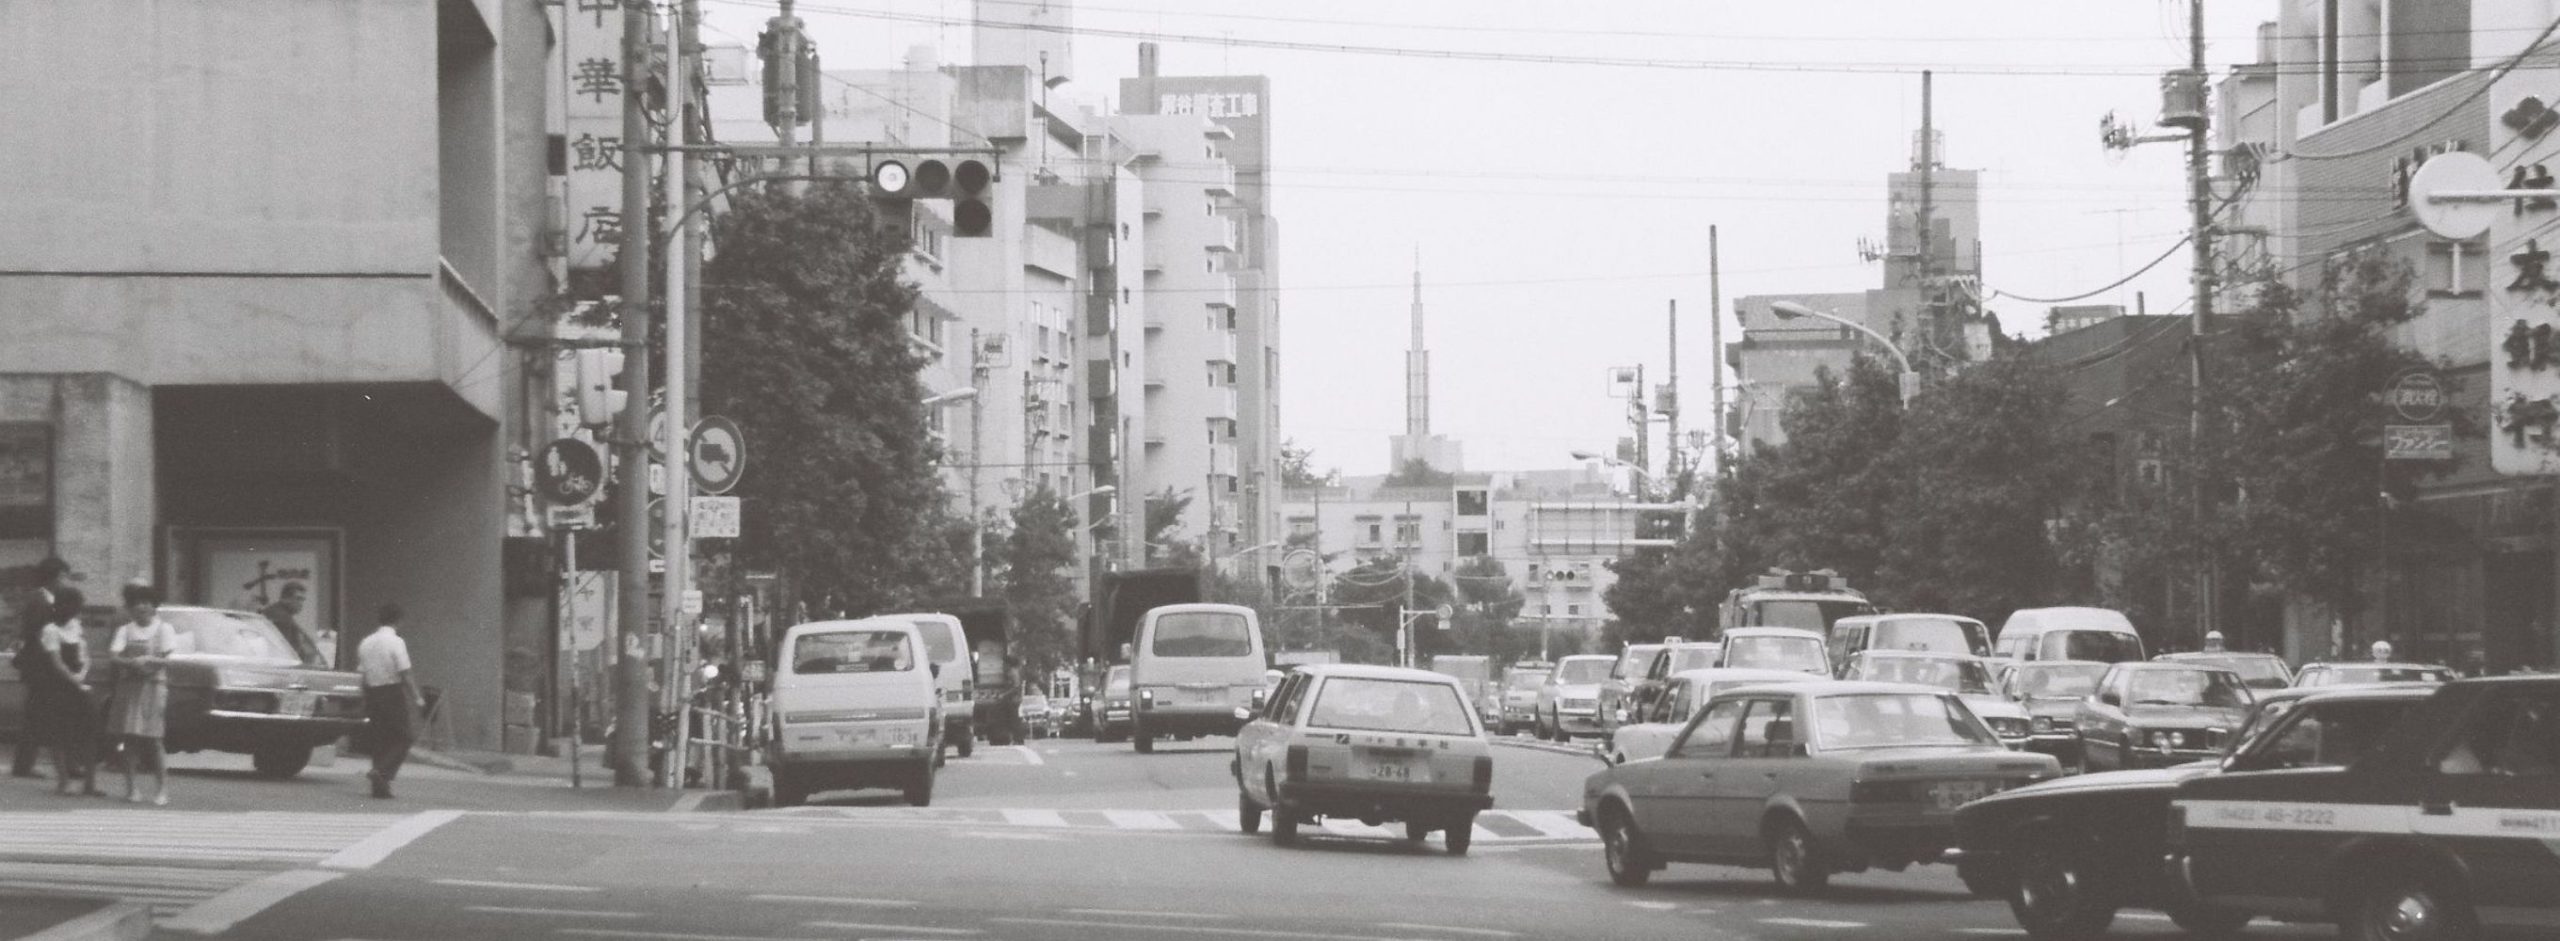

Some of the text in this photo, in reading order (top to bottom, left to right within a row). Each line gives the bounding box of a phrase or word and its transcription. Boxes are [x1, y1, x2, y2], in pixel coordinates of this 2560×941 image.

[573, 0, 623, 244] 中華飯店
[2502, 164, 2559, 450] 住友銀行
